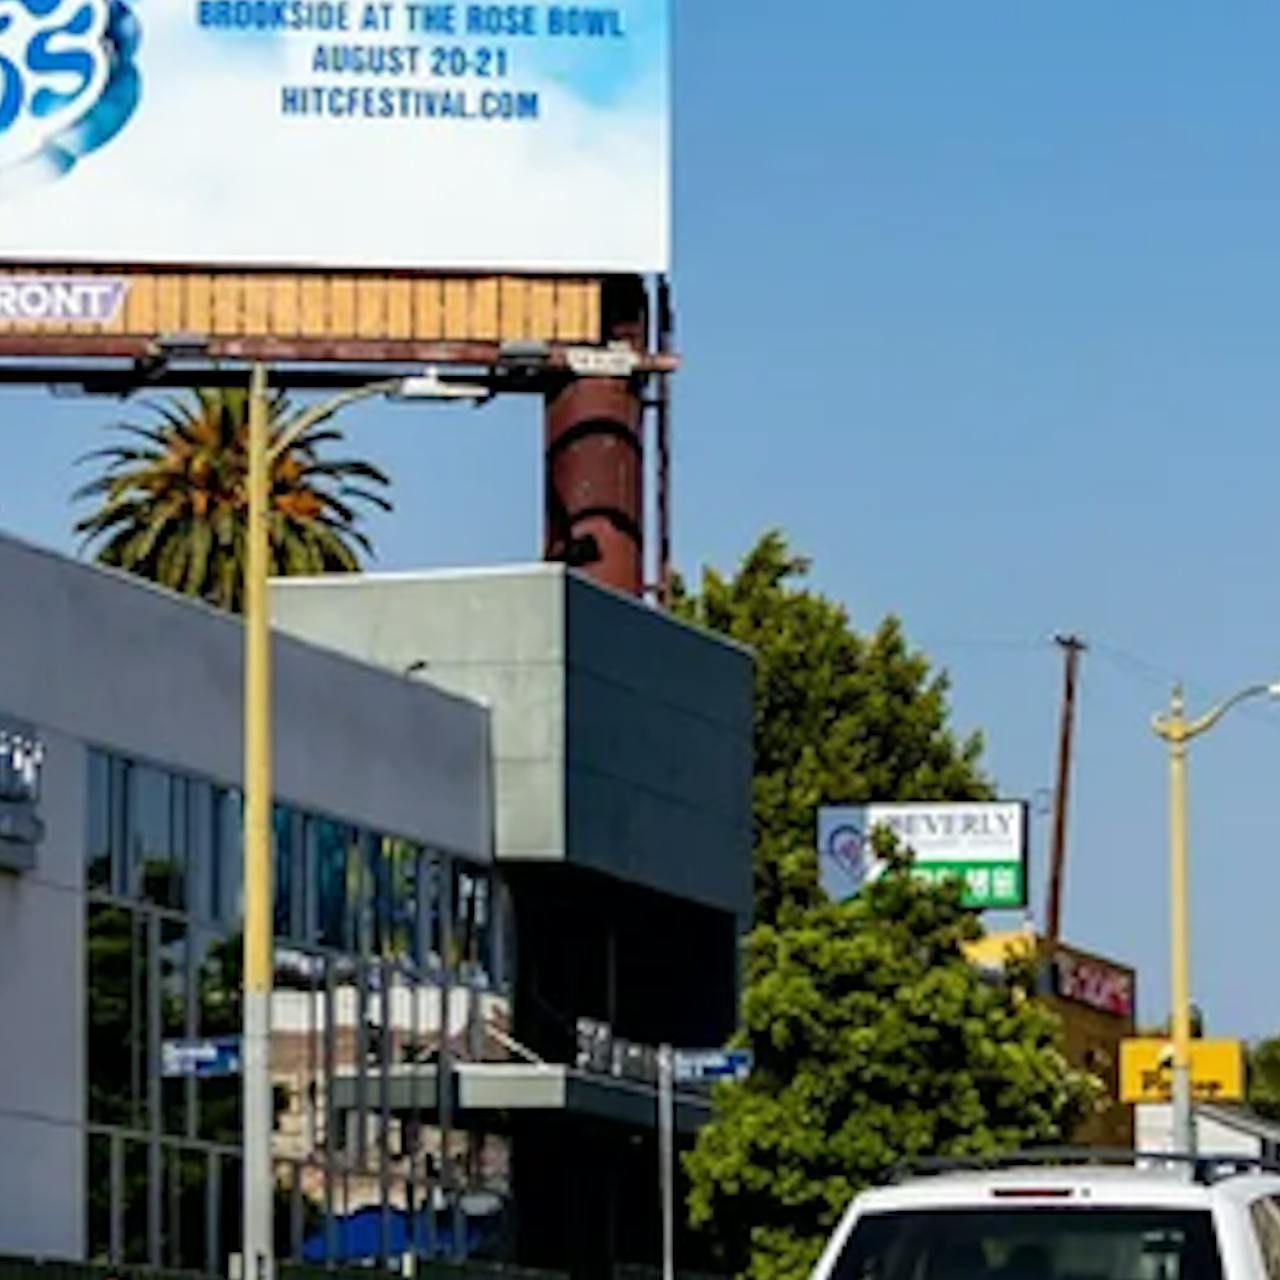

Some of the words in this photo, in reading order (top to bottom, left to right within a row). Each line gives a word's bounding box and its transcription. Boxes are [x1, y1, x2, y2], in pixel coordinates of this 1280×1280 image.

[197, 0, 349, 31] BROOKSIDE
[359, 4, 395, 31] AT
[405, 6, 456, 35] THE
[466, 5, 537, 35] ROSE
[546, 8, 625, 37] BOWL
[312, 45, 420, 73] AUGUST
[430, 48, 508, 76] 20-21
[281, 86, 540, 119] HITCFESTIVAL.COM
